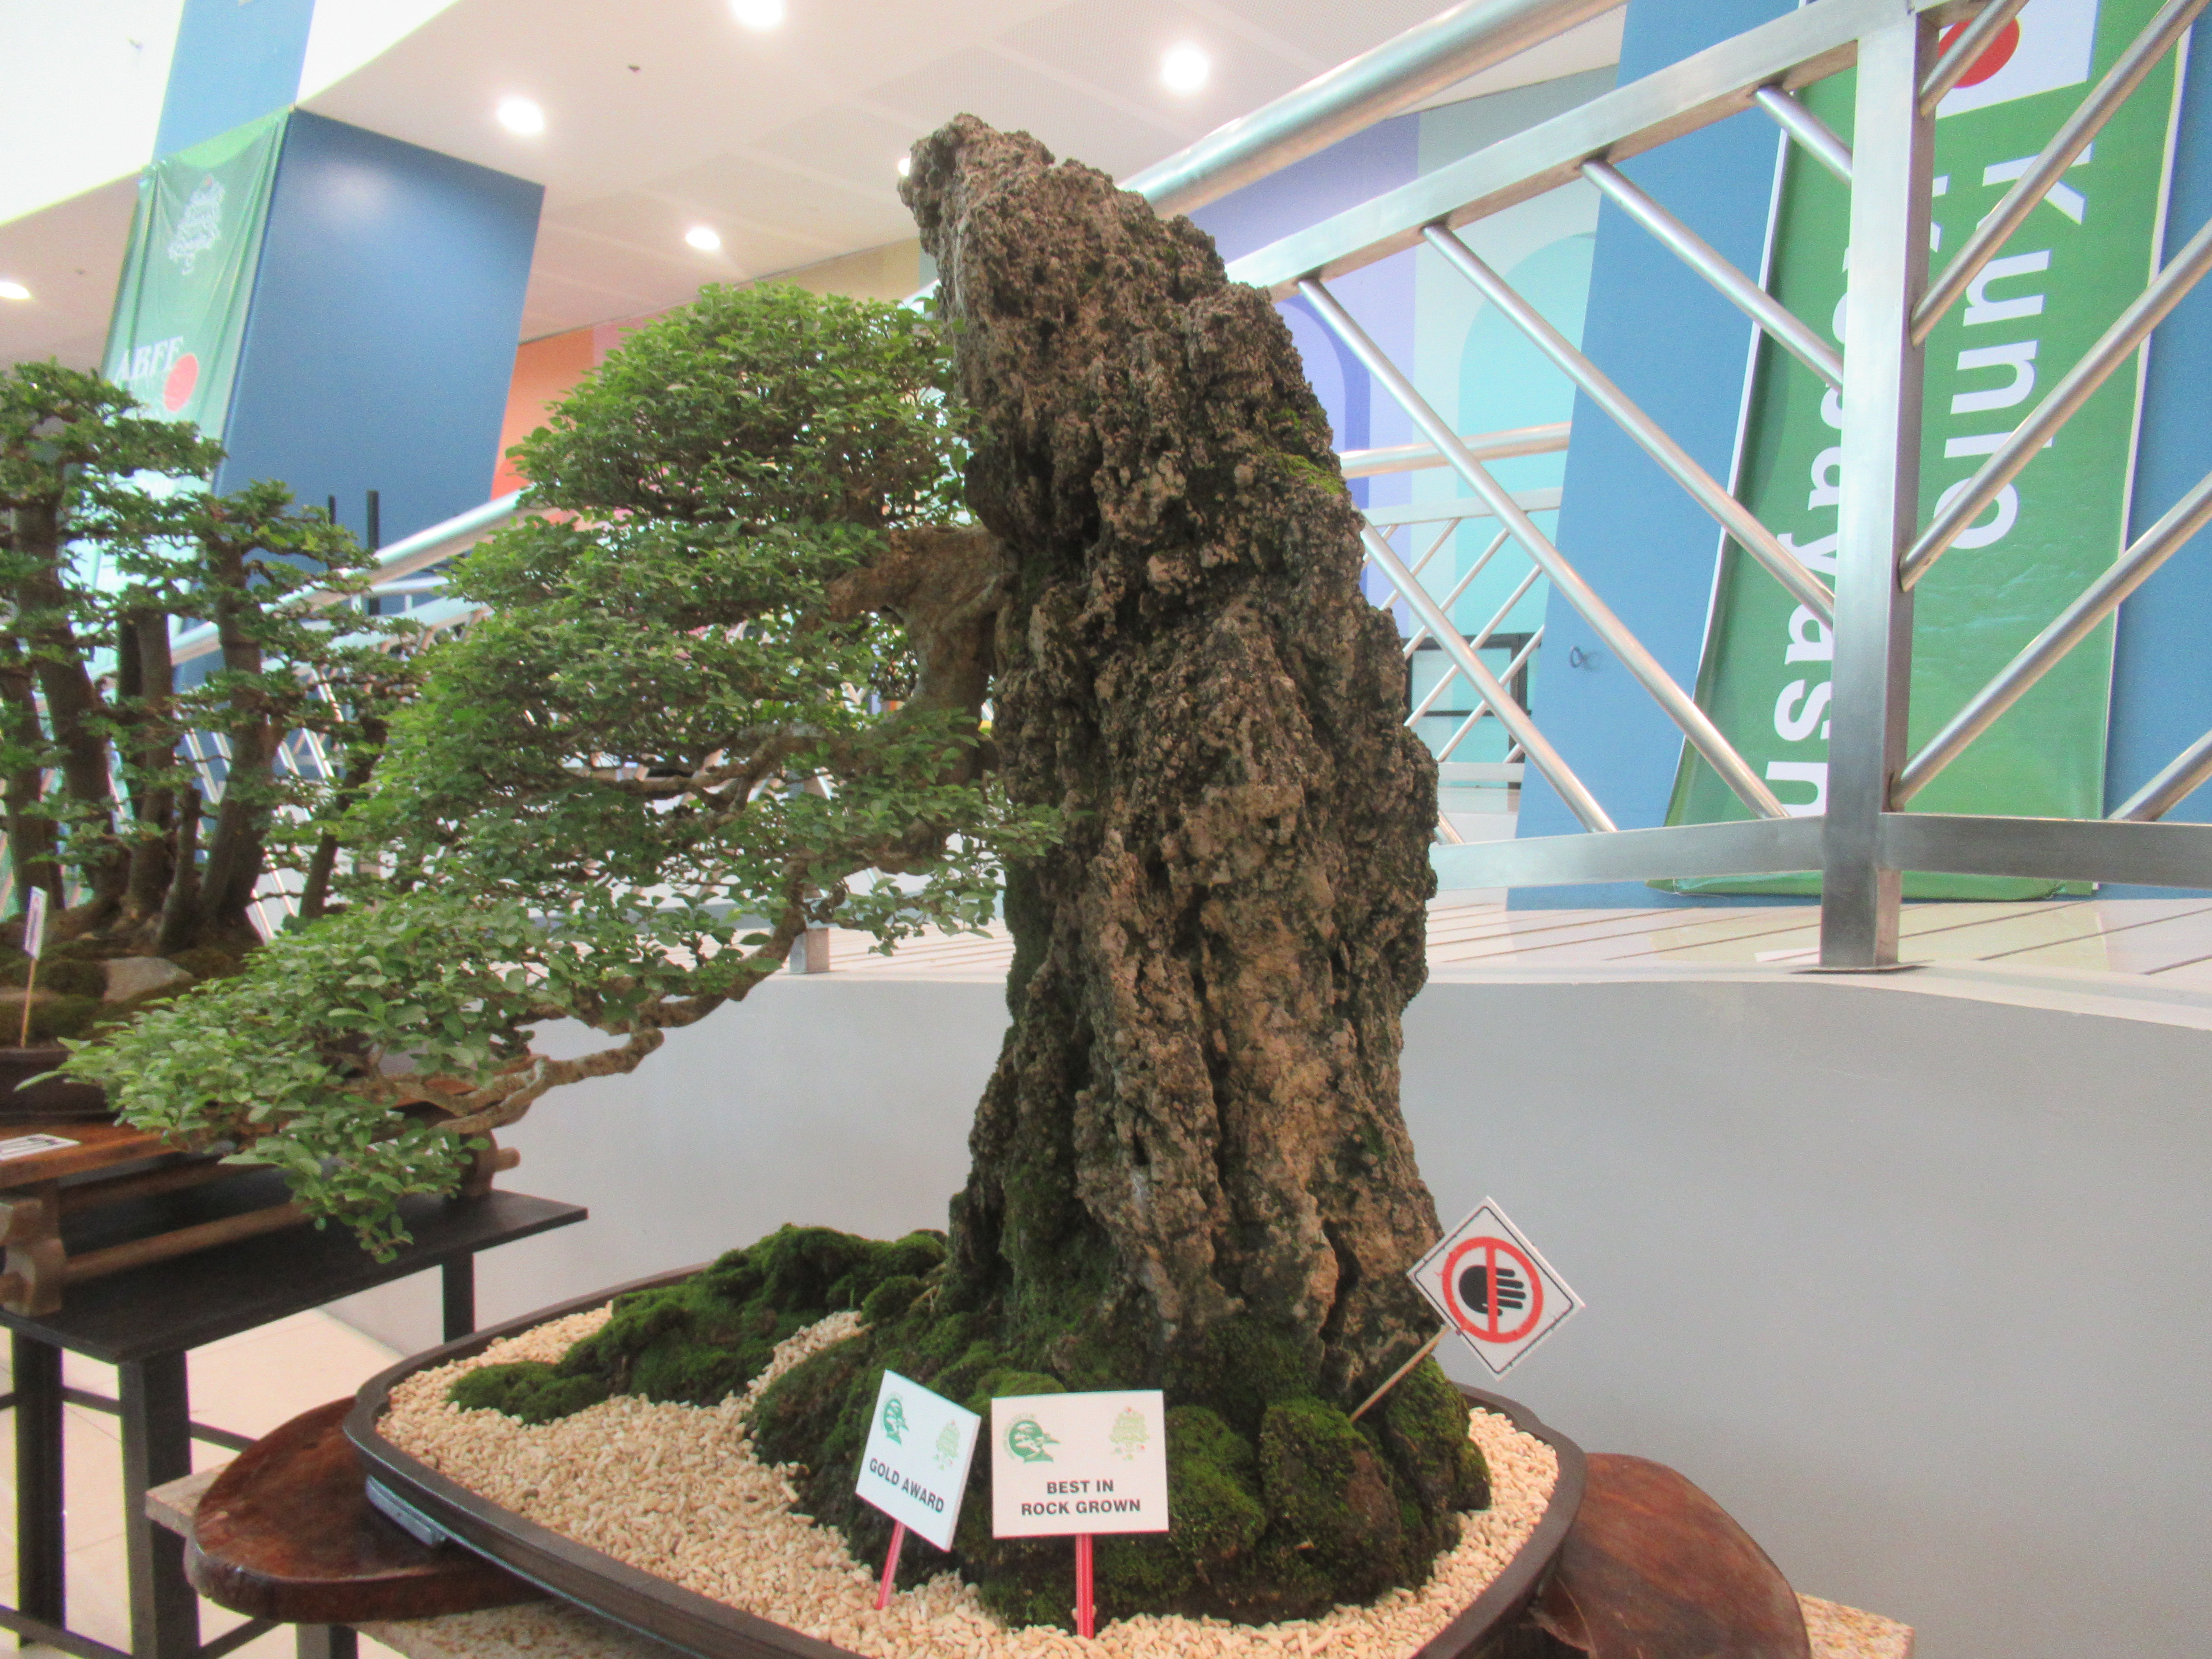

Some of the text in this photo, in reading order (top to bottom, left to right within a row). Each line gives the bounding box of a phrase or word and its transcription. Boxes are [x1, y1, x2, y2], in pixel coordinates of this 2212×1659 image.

[870, 1457, 944, 1513] GOLD AWARD
[1047, 1479, 1114, 1494] BEST IN
[1021, 1498, 1141, 1516] ROCK GROWN
